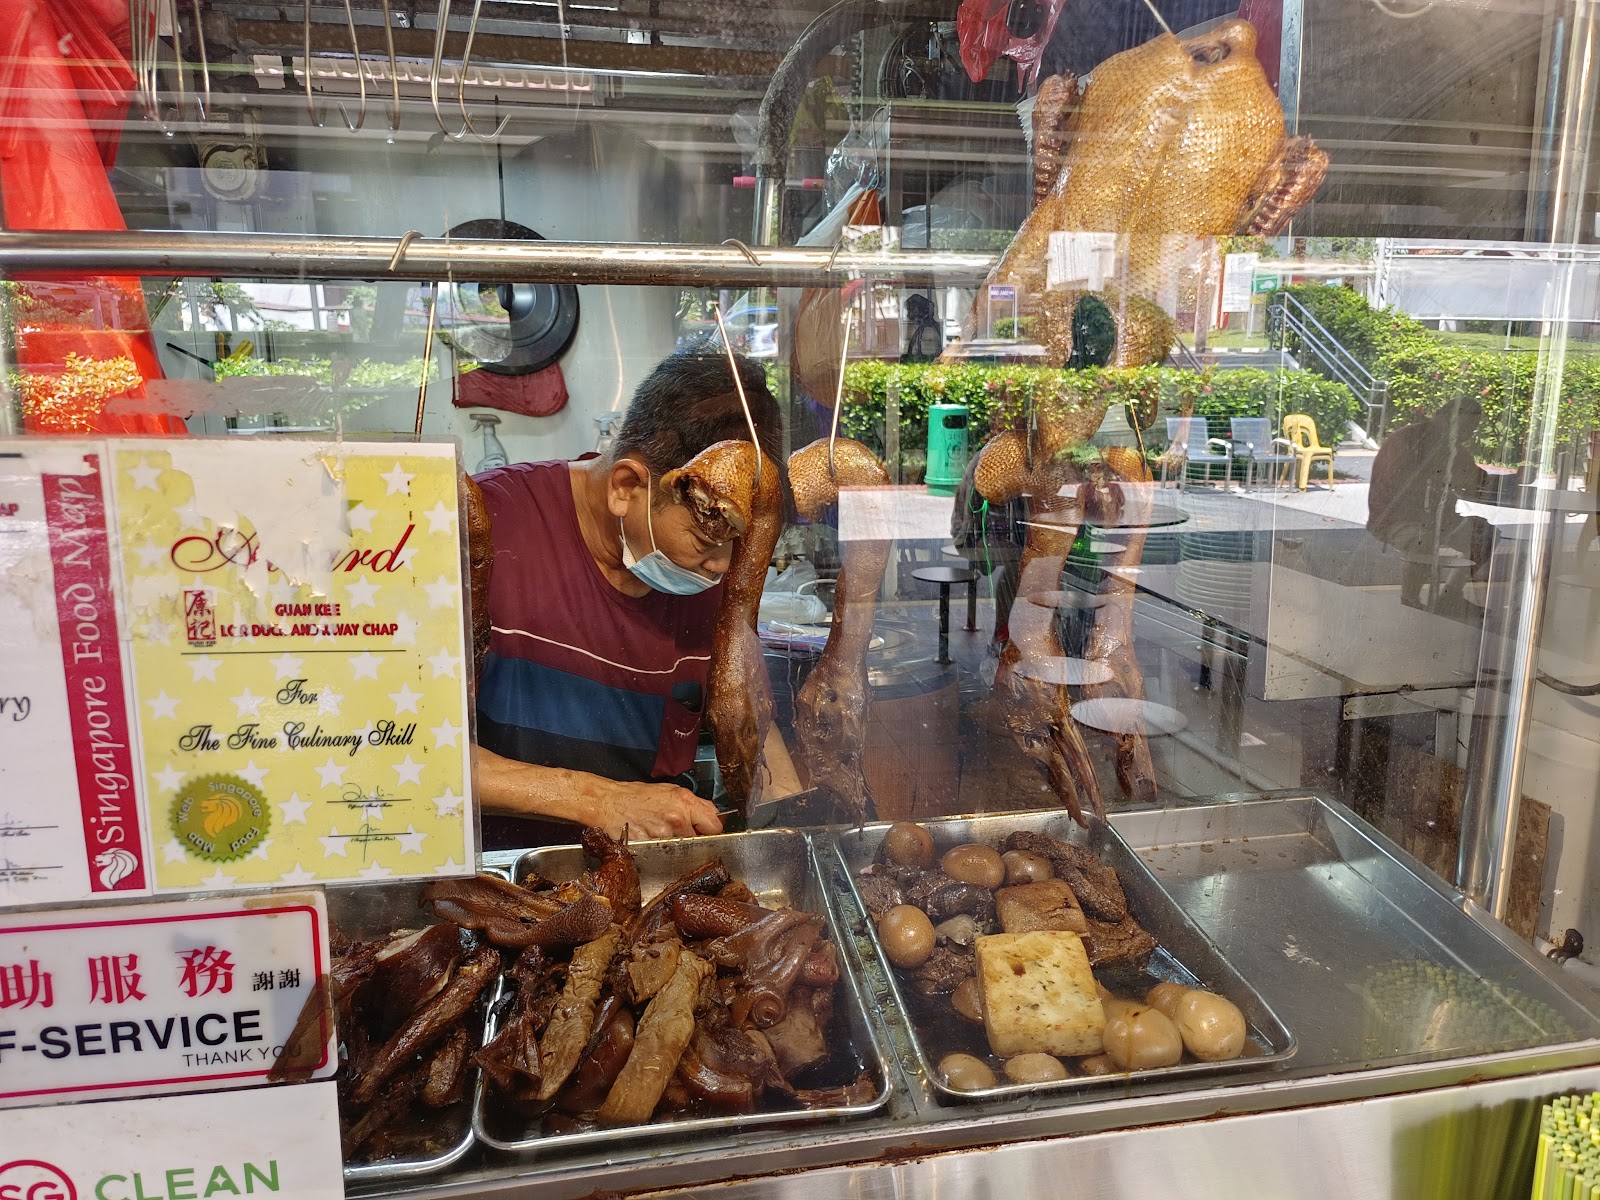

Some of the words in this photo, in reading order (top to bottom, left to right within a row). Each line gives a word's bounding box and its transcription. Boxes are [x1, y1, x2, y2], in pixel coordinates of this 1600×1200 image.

[58, 478, 97, 569] Map
[171, 524, 415, 572] Ard
[275, 603, 311, 616] GUAN
[315, 603, 341, 616] KEE
[62, 582, 102, 664] Food
[363, 623, 398, 636] CHAP
[276, 679, 317, 705] For
[178, 724, 220, 751] The
[227, 723, 277, 750] Fine
[283, 721, 362, 756] Culinary
[368, 719, 417, 746] Skill
[83, 676, 130, 843] Singapore
[177, 797, 194, 822] Web
[208, 782, 262, 817] Singapore
[187, 832, 215, 853] Map
[230, 826, 260, 852] Food
[252, 968, 301, 992] 謝謝
[182, 1048, 253, 1067] THANK
[95, 1160, 280, 1200] CLEAN
